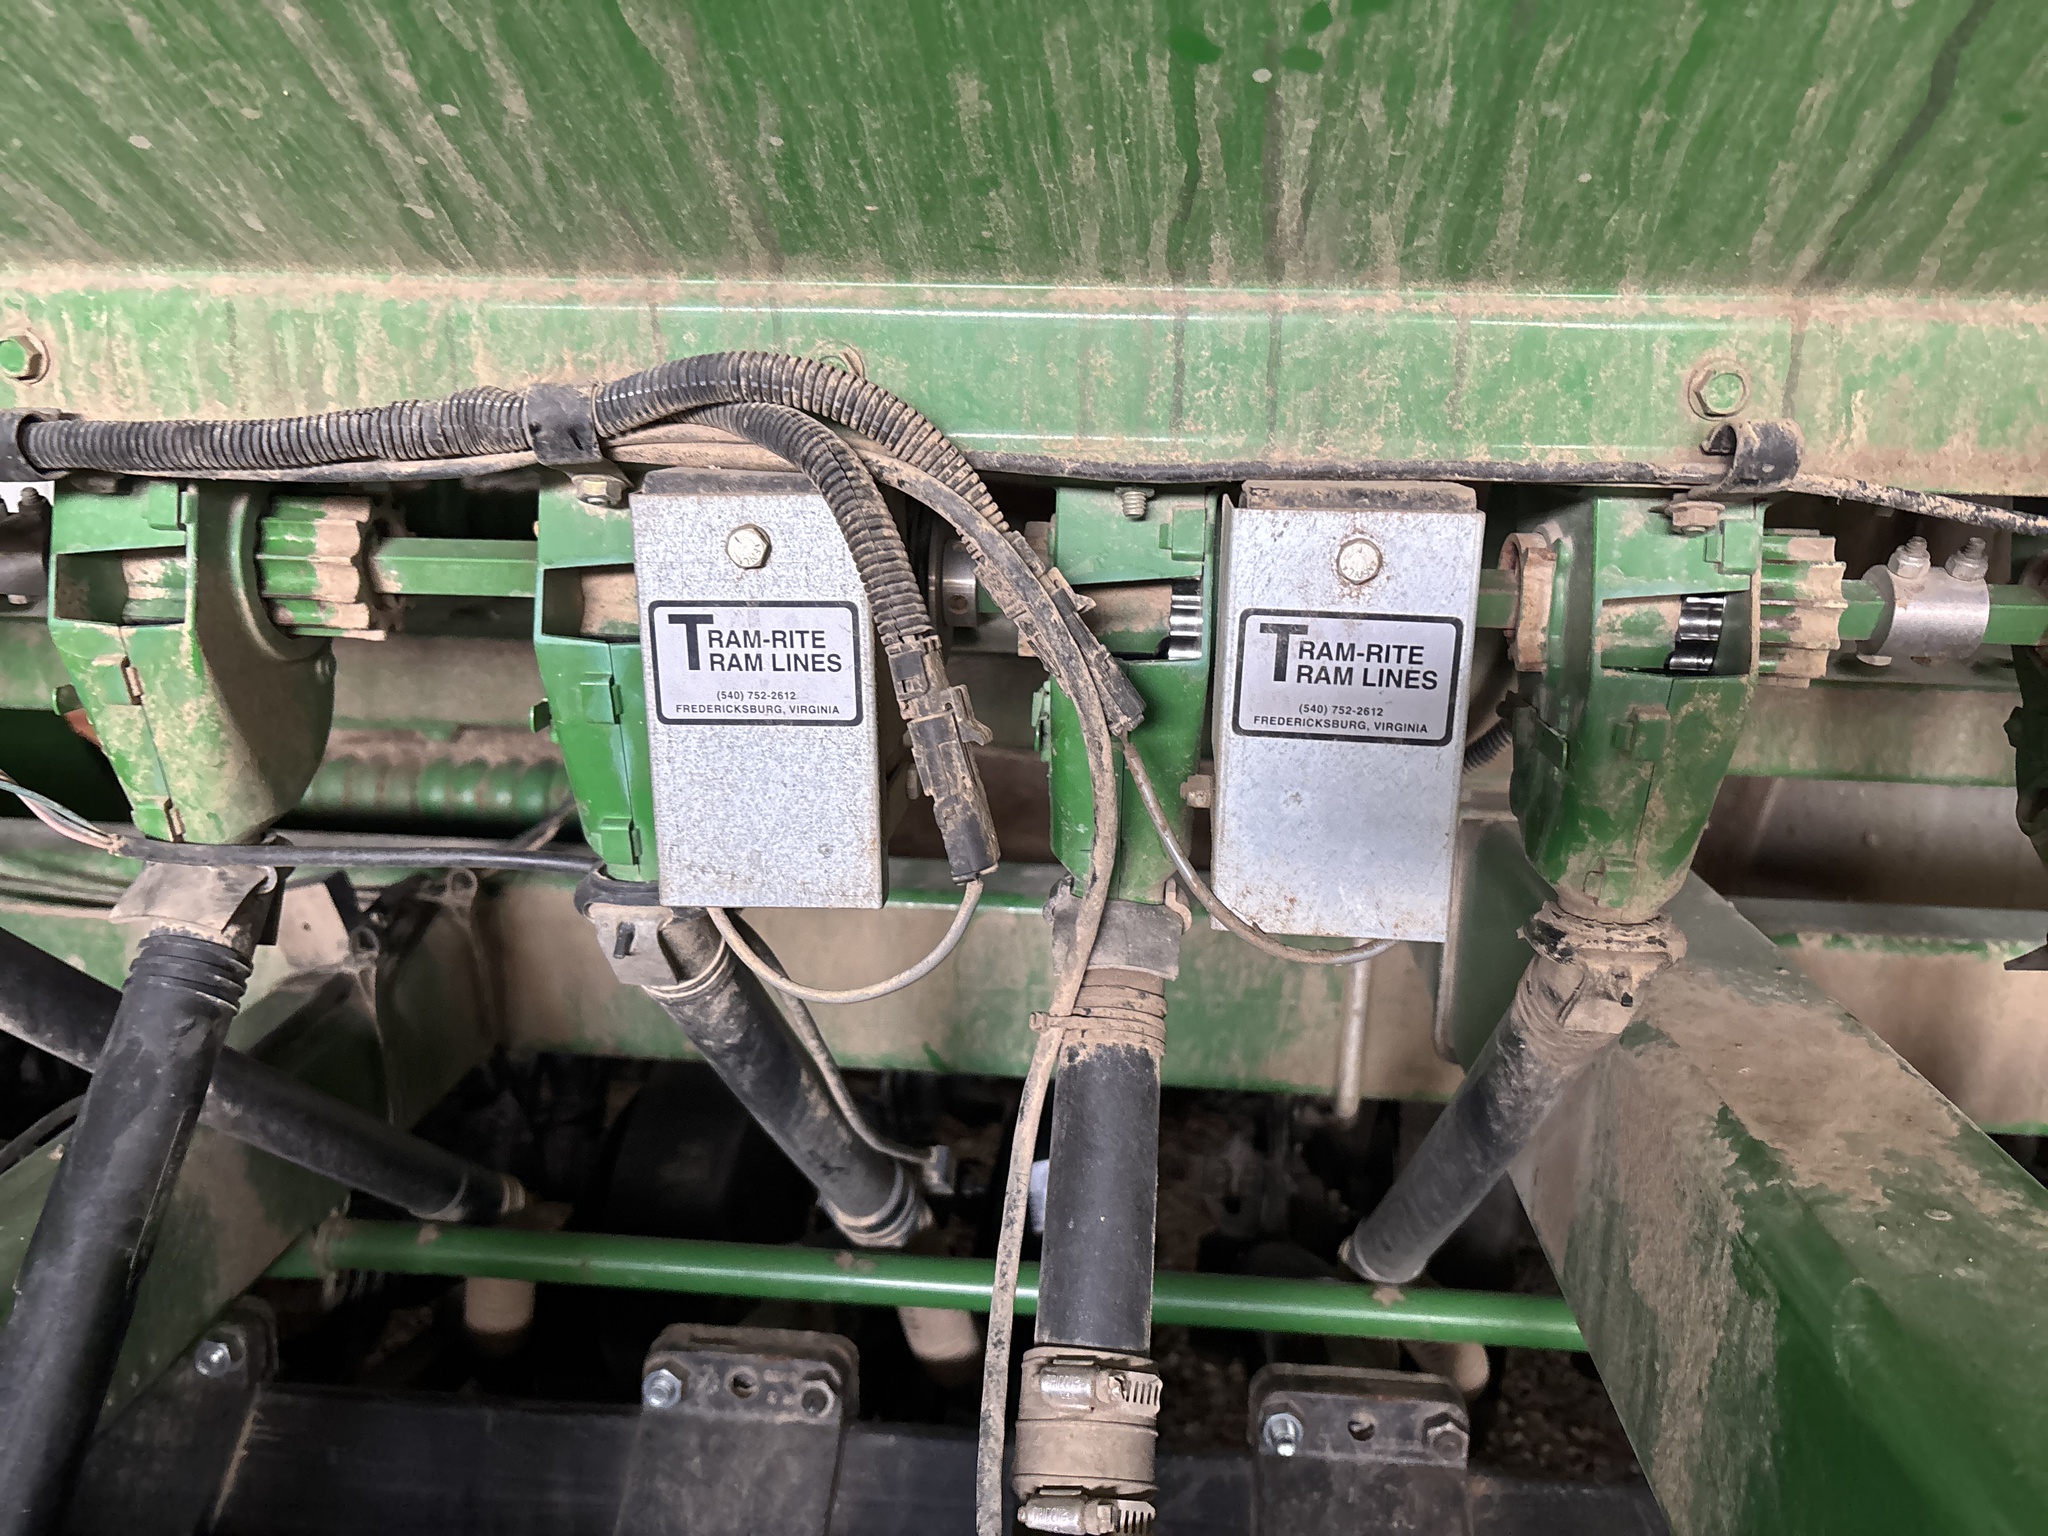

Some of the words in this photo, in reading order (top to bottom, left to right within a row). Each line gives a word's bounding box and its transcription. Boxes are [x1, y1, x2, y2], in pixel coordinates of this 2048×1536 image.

[772, 653, 843, 673] LINES
[1362, 668, 1438, 690] LINES
[716, 691, 744, 702] (540)
[748, 691, 797, 701] 752-2612
[676, 704, 786, 715] FREDERICKSBURG,
[789, 705, 840, 715] VIRGINIA
[1298, 704, 1328, 716] (540)
[1331, 705, 1384, 717] 752-2612
[1253, 716, 1370, 732] FREDERICKSBURG,
[1373, 722, 1428, 734] VIRGINIA
